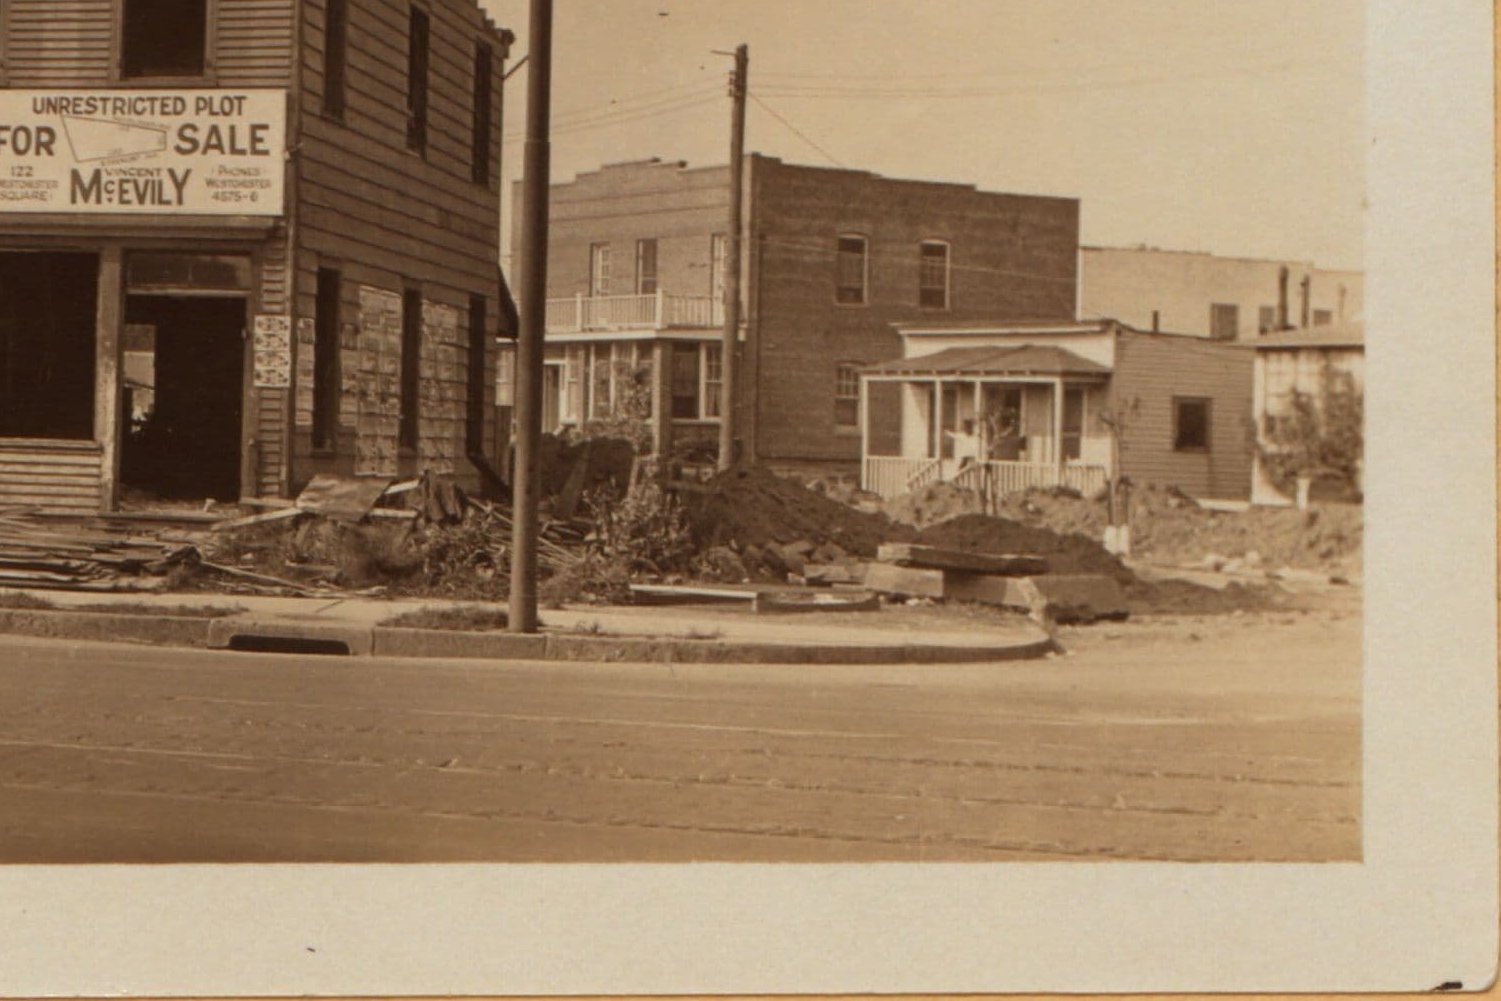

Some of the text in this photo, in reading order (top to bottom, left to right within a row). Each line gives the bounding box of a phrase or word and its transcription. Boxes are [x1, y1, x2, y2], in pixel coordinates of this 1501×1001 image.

[32, 95, 247, 116] UNRESTRICTED PLOT
[173, 123, 271, 156] SALE
[102, 168, 163, 177] VINCENT
